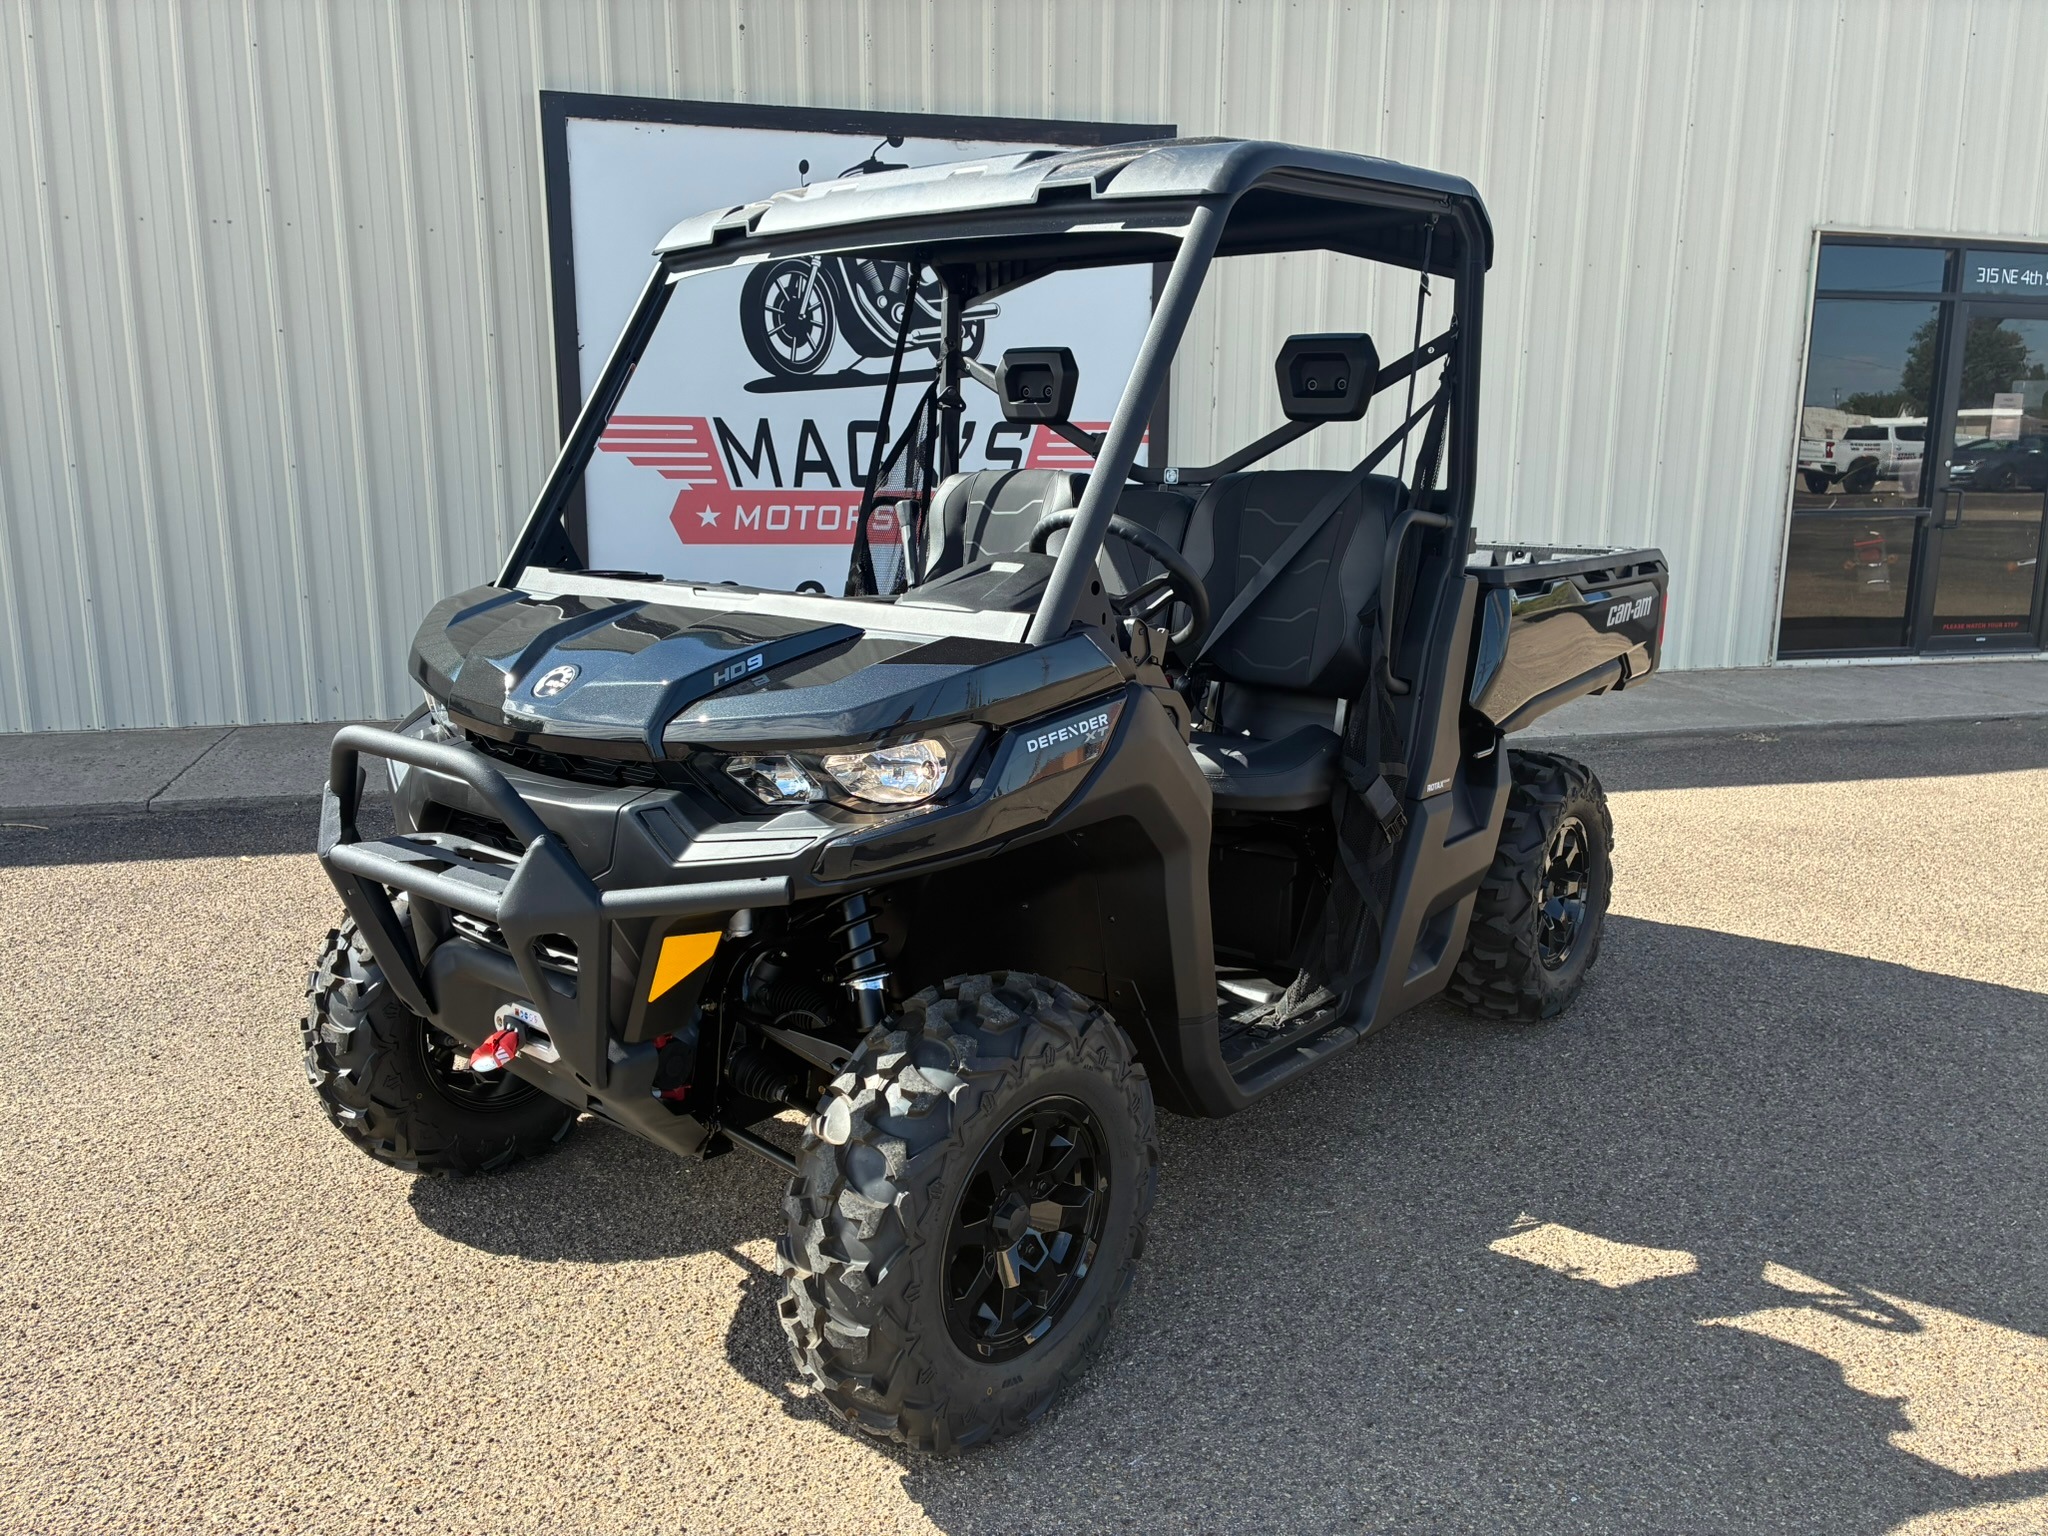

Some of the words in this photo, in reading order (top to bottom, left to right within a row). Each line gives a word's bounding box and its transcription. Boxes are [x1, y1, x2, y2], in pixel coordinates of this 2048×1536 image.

[1976, 266, 1999, 284] 315
[2001, 268, 2019, 285] NE
[2020, 269, 2043, 286] 4th
[713, 653, 763, 687] HD9
[1026, 713, 1109, 753] DEFENDER
[1084, 725, 1109, 743] XT
